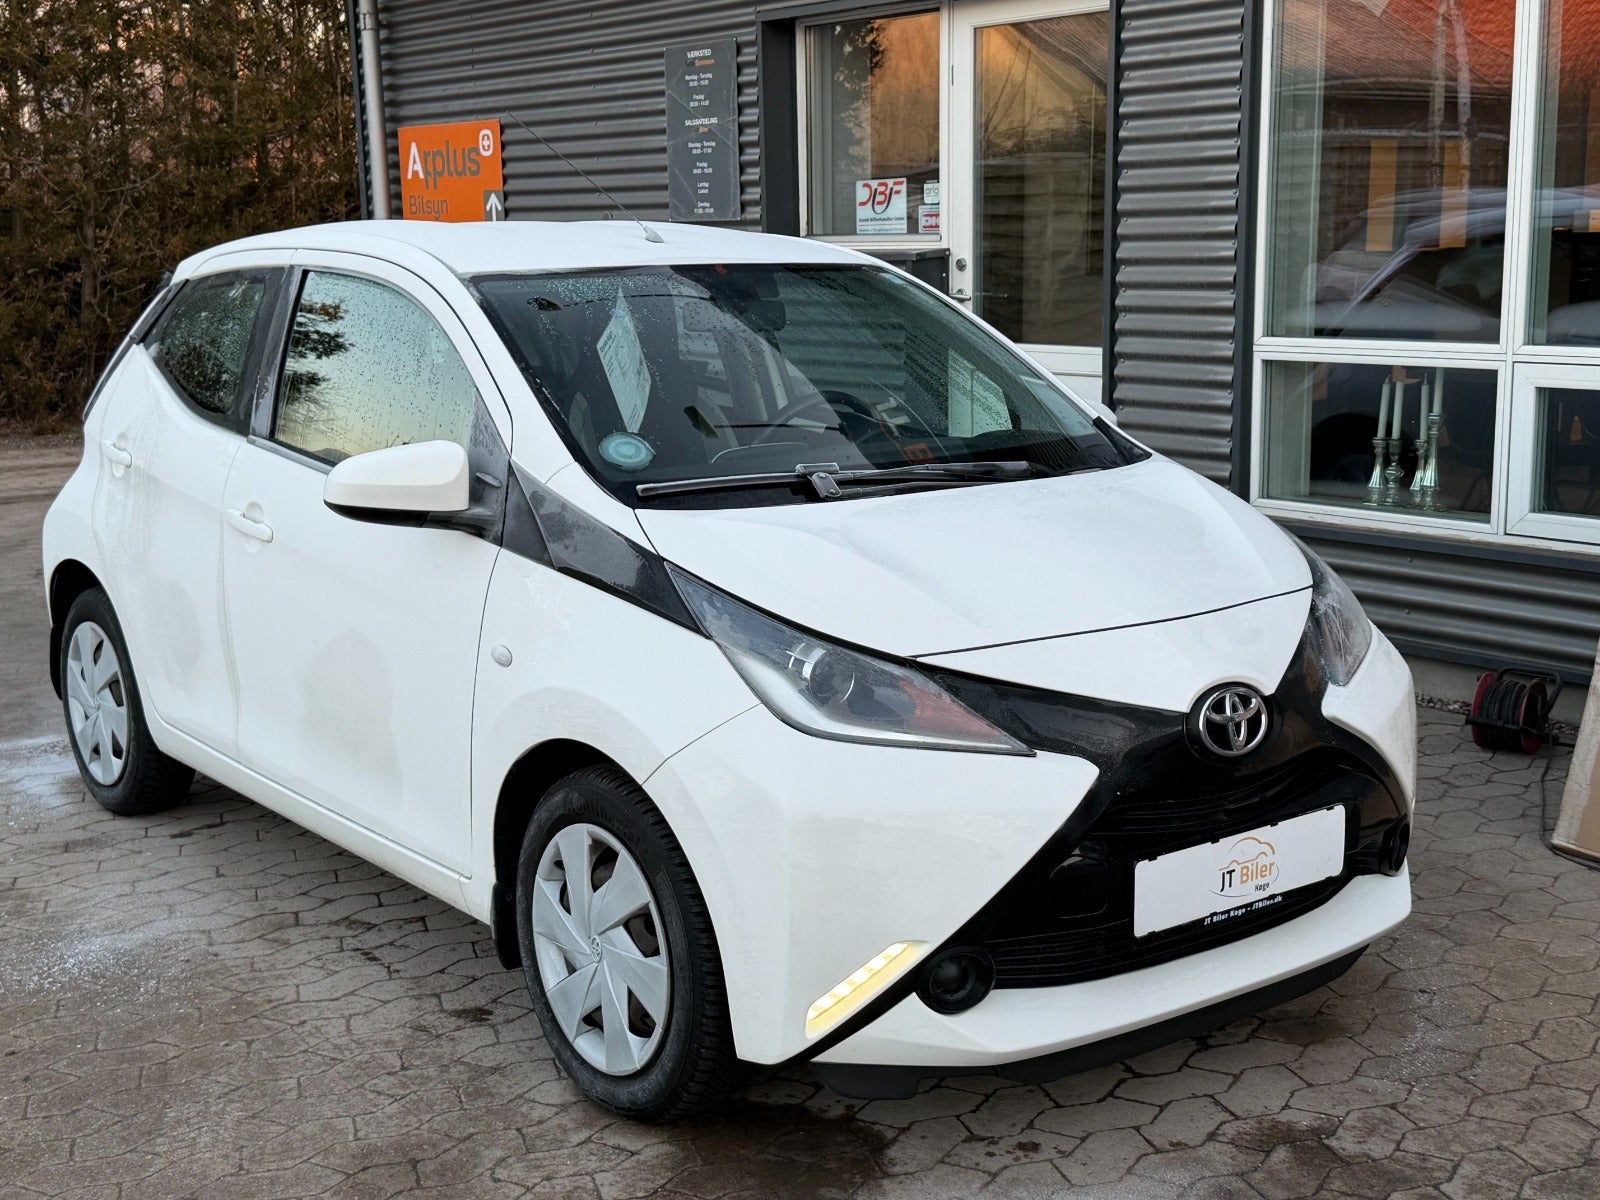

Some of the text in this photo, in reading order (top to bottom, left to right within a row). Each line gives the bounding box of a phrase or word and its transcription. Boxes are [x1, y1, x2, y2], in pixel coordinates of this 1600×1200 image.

[409, 195, 449, 221] Bilsyn
[1220, 861, 1275, 893] JT Biler
[1203, 917, 1212, 925] JT
[1212, 913, 1229, 923] Biler
